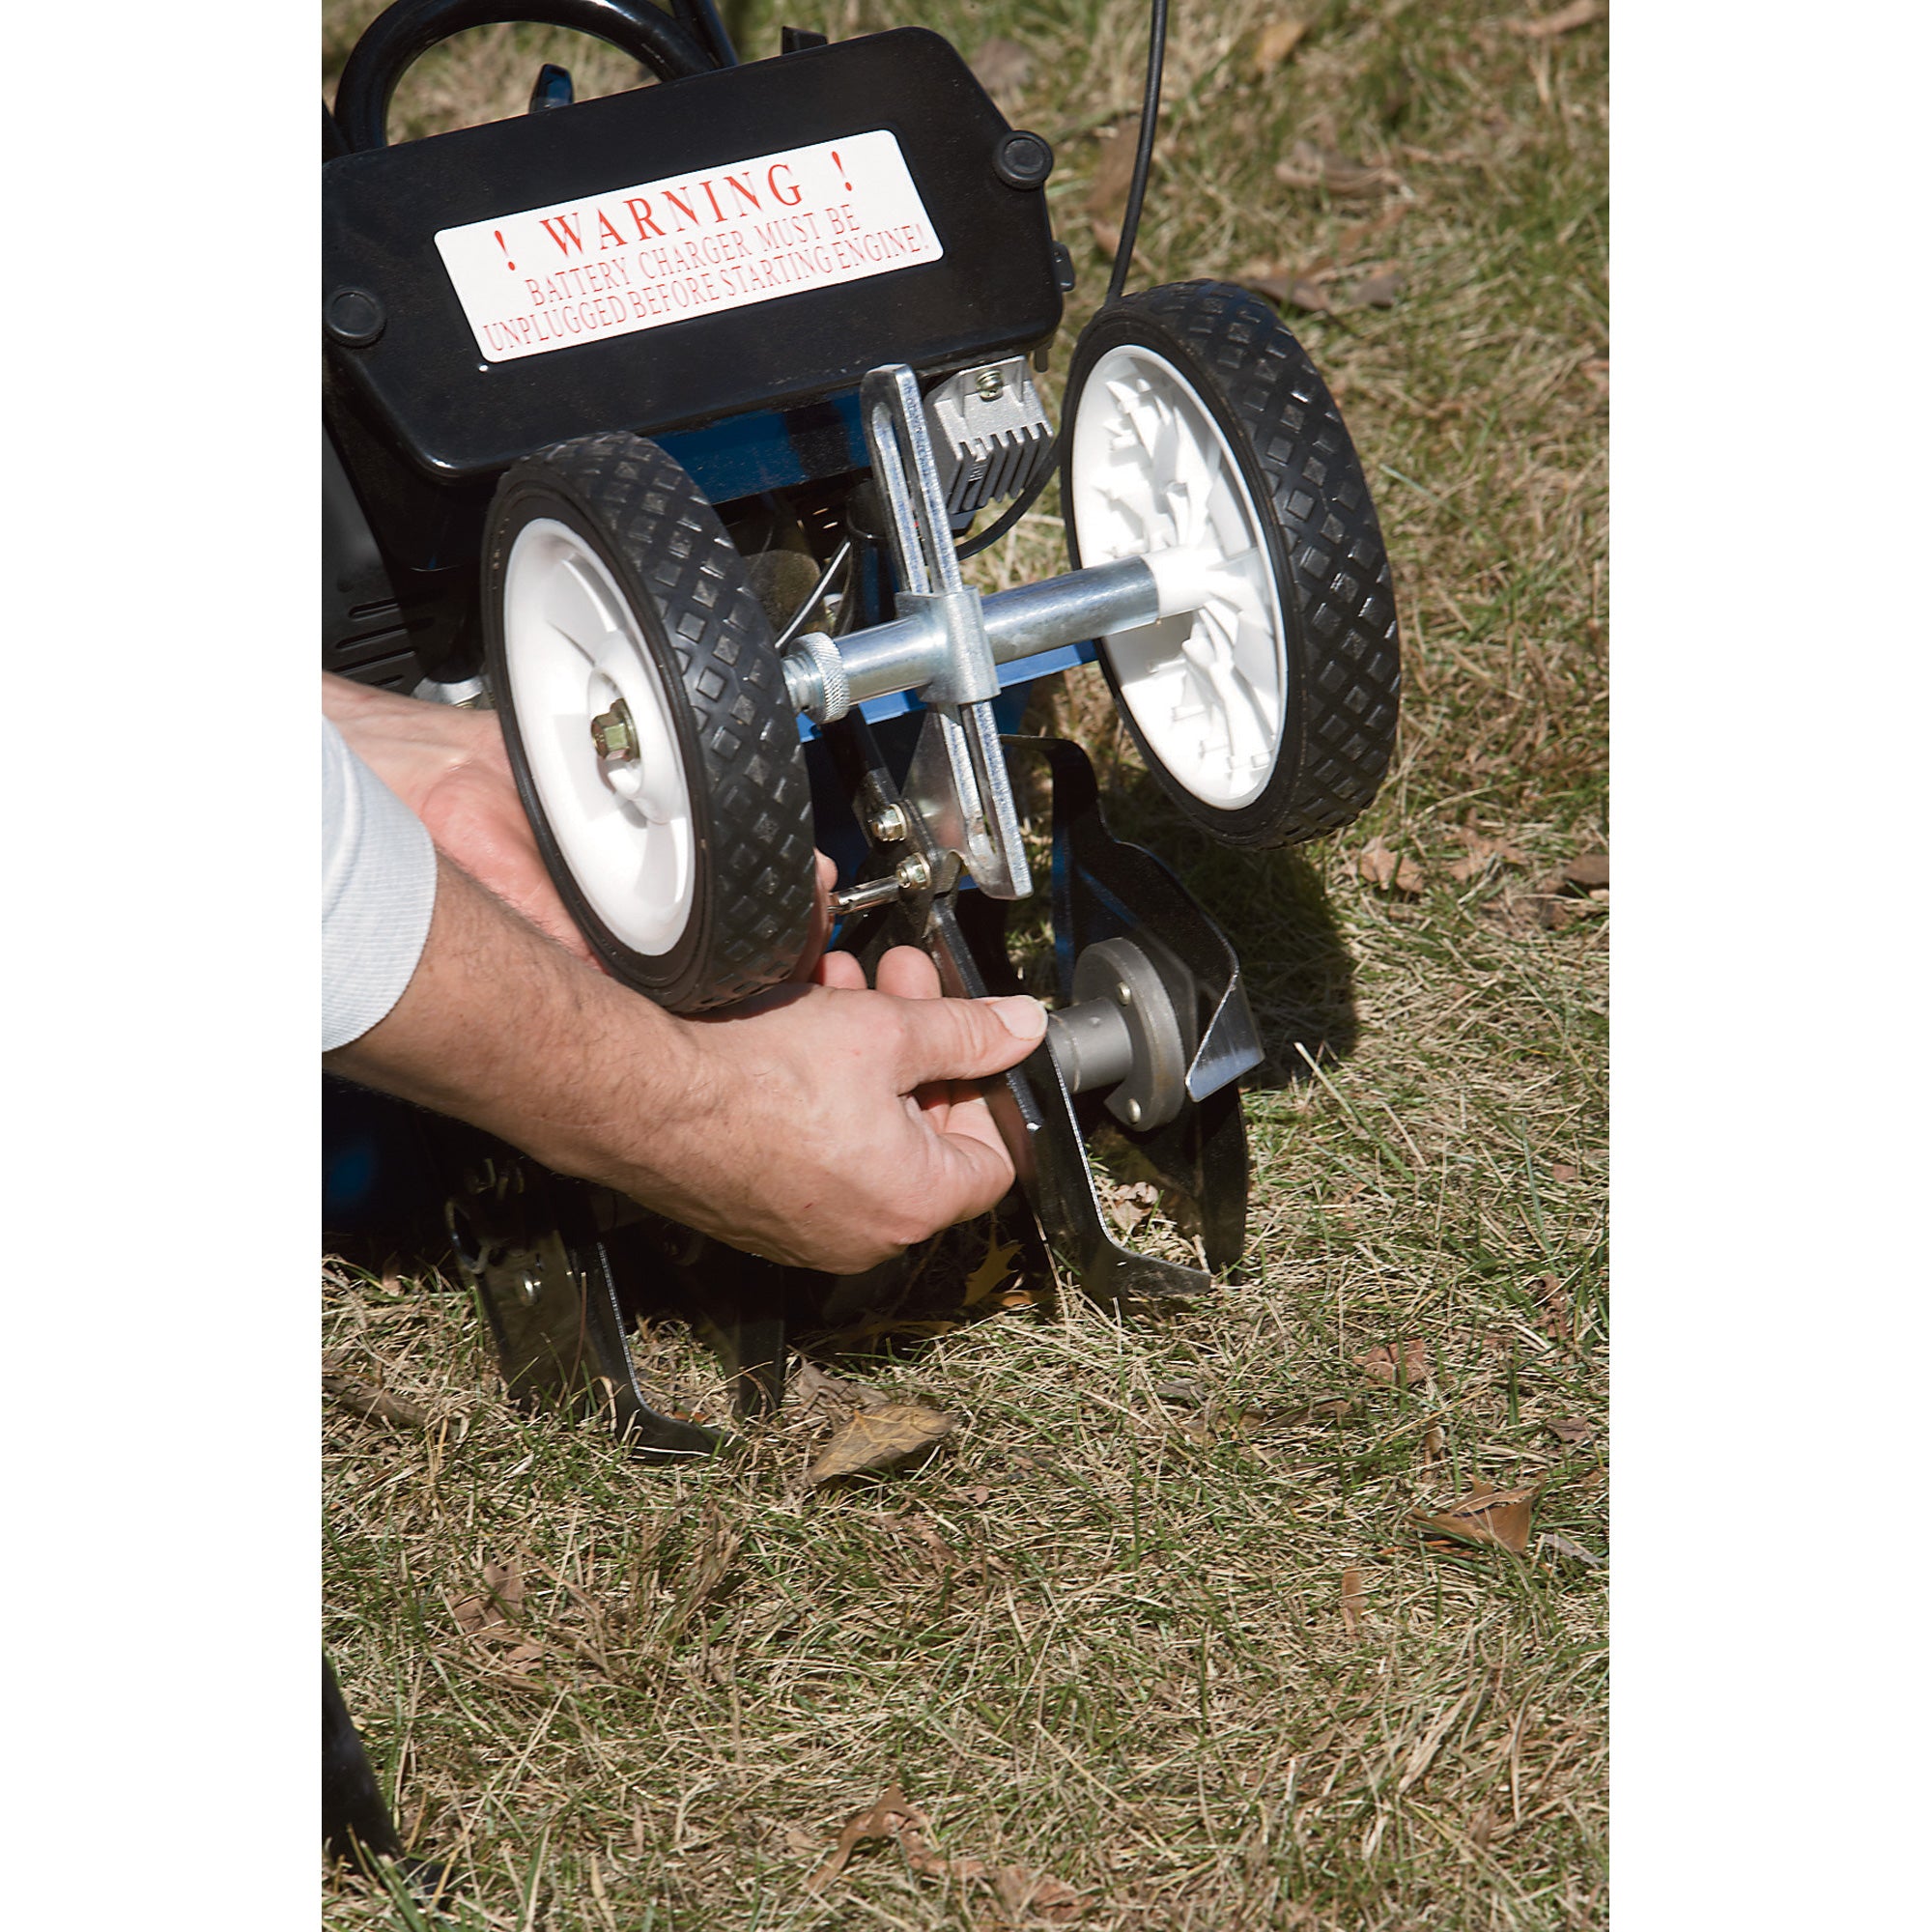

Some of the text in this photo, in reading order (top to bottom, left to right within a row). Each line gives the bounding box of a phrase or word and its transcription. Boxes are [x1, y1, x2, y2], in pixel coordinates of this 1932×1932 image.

[525, 203, 862, 306] BATTERY CHARGER MUST BE
[539, 162, 804, 258] WARNING
[483, 223, 929, 353] UNPLUGGED BEFORE STARTING ENGINE!
